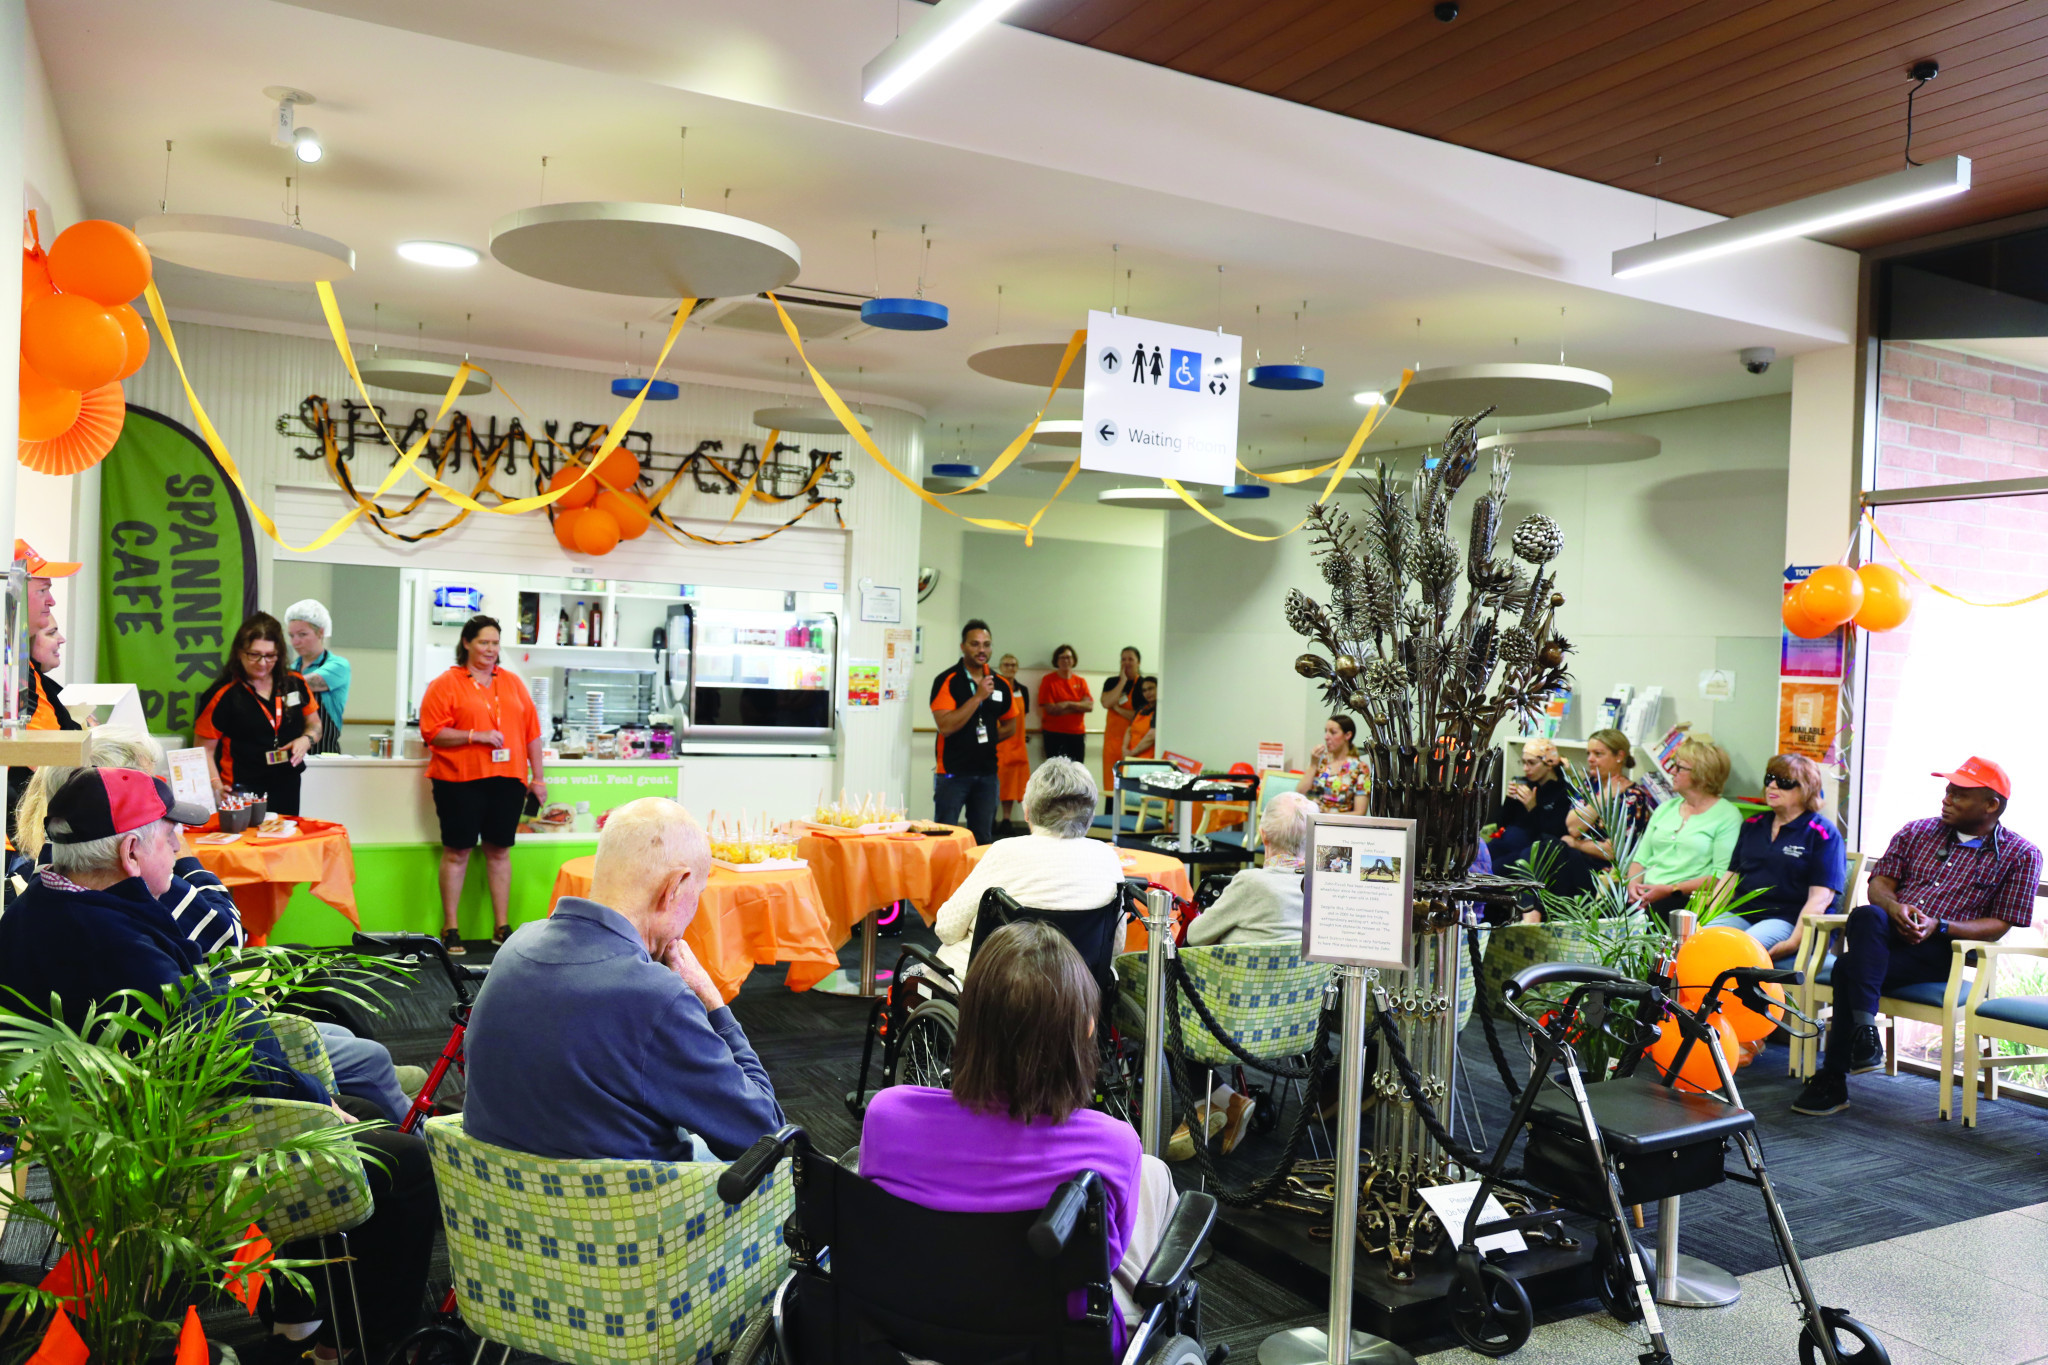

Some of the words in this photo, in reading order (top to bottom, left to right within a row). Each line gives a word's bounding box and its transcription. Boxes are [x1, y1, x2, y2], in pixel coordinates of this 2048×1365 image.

[1128, 428, 1182, 453] Waiting
[1187, 436, 1227, 455] Room
[110, 520, 165, 636] CAFE
[165, 473, 225, 683] SPANNER
[1789, 725, 1827, 737] AVAILABLE
[1797, 733, 1817, 744] HERE
[570, 774, 602, 785] well.
[605, 774, 634, 785] Feel
[636, 774, 674, 787] great.
